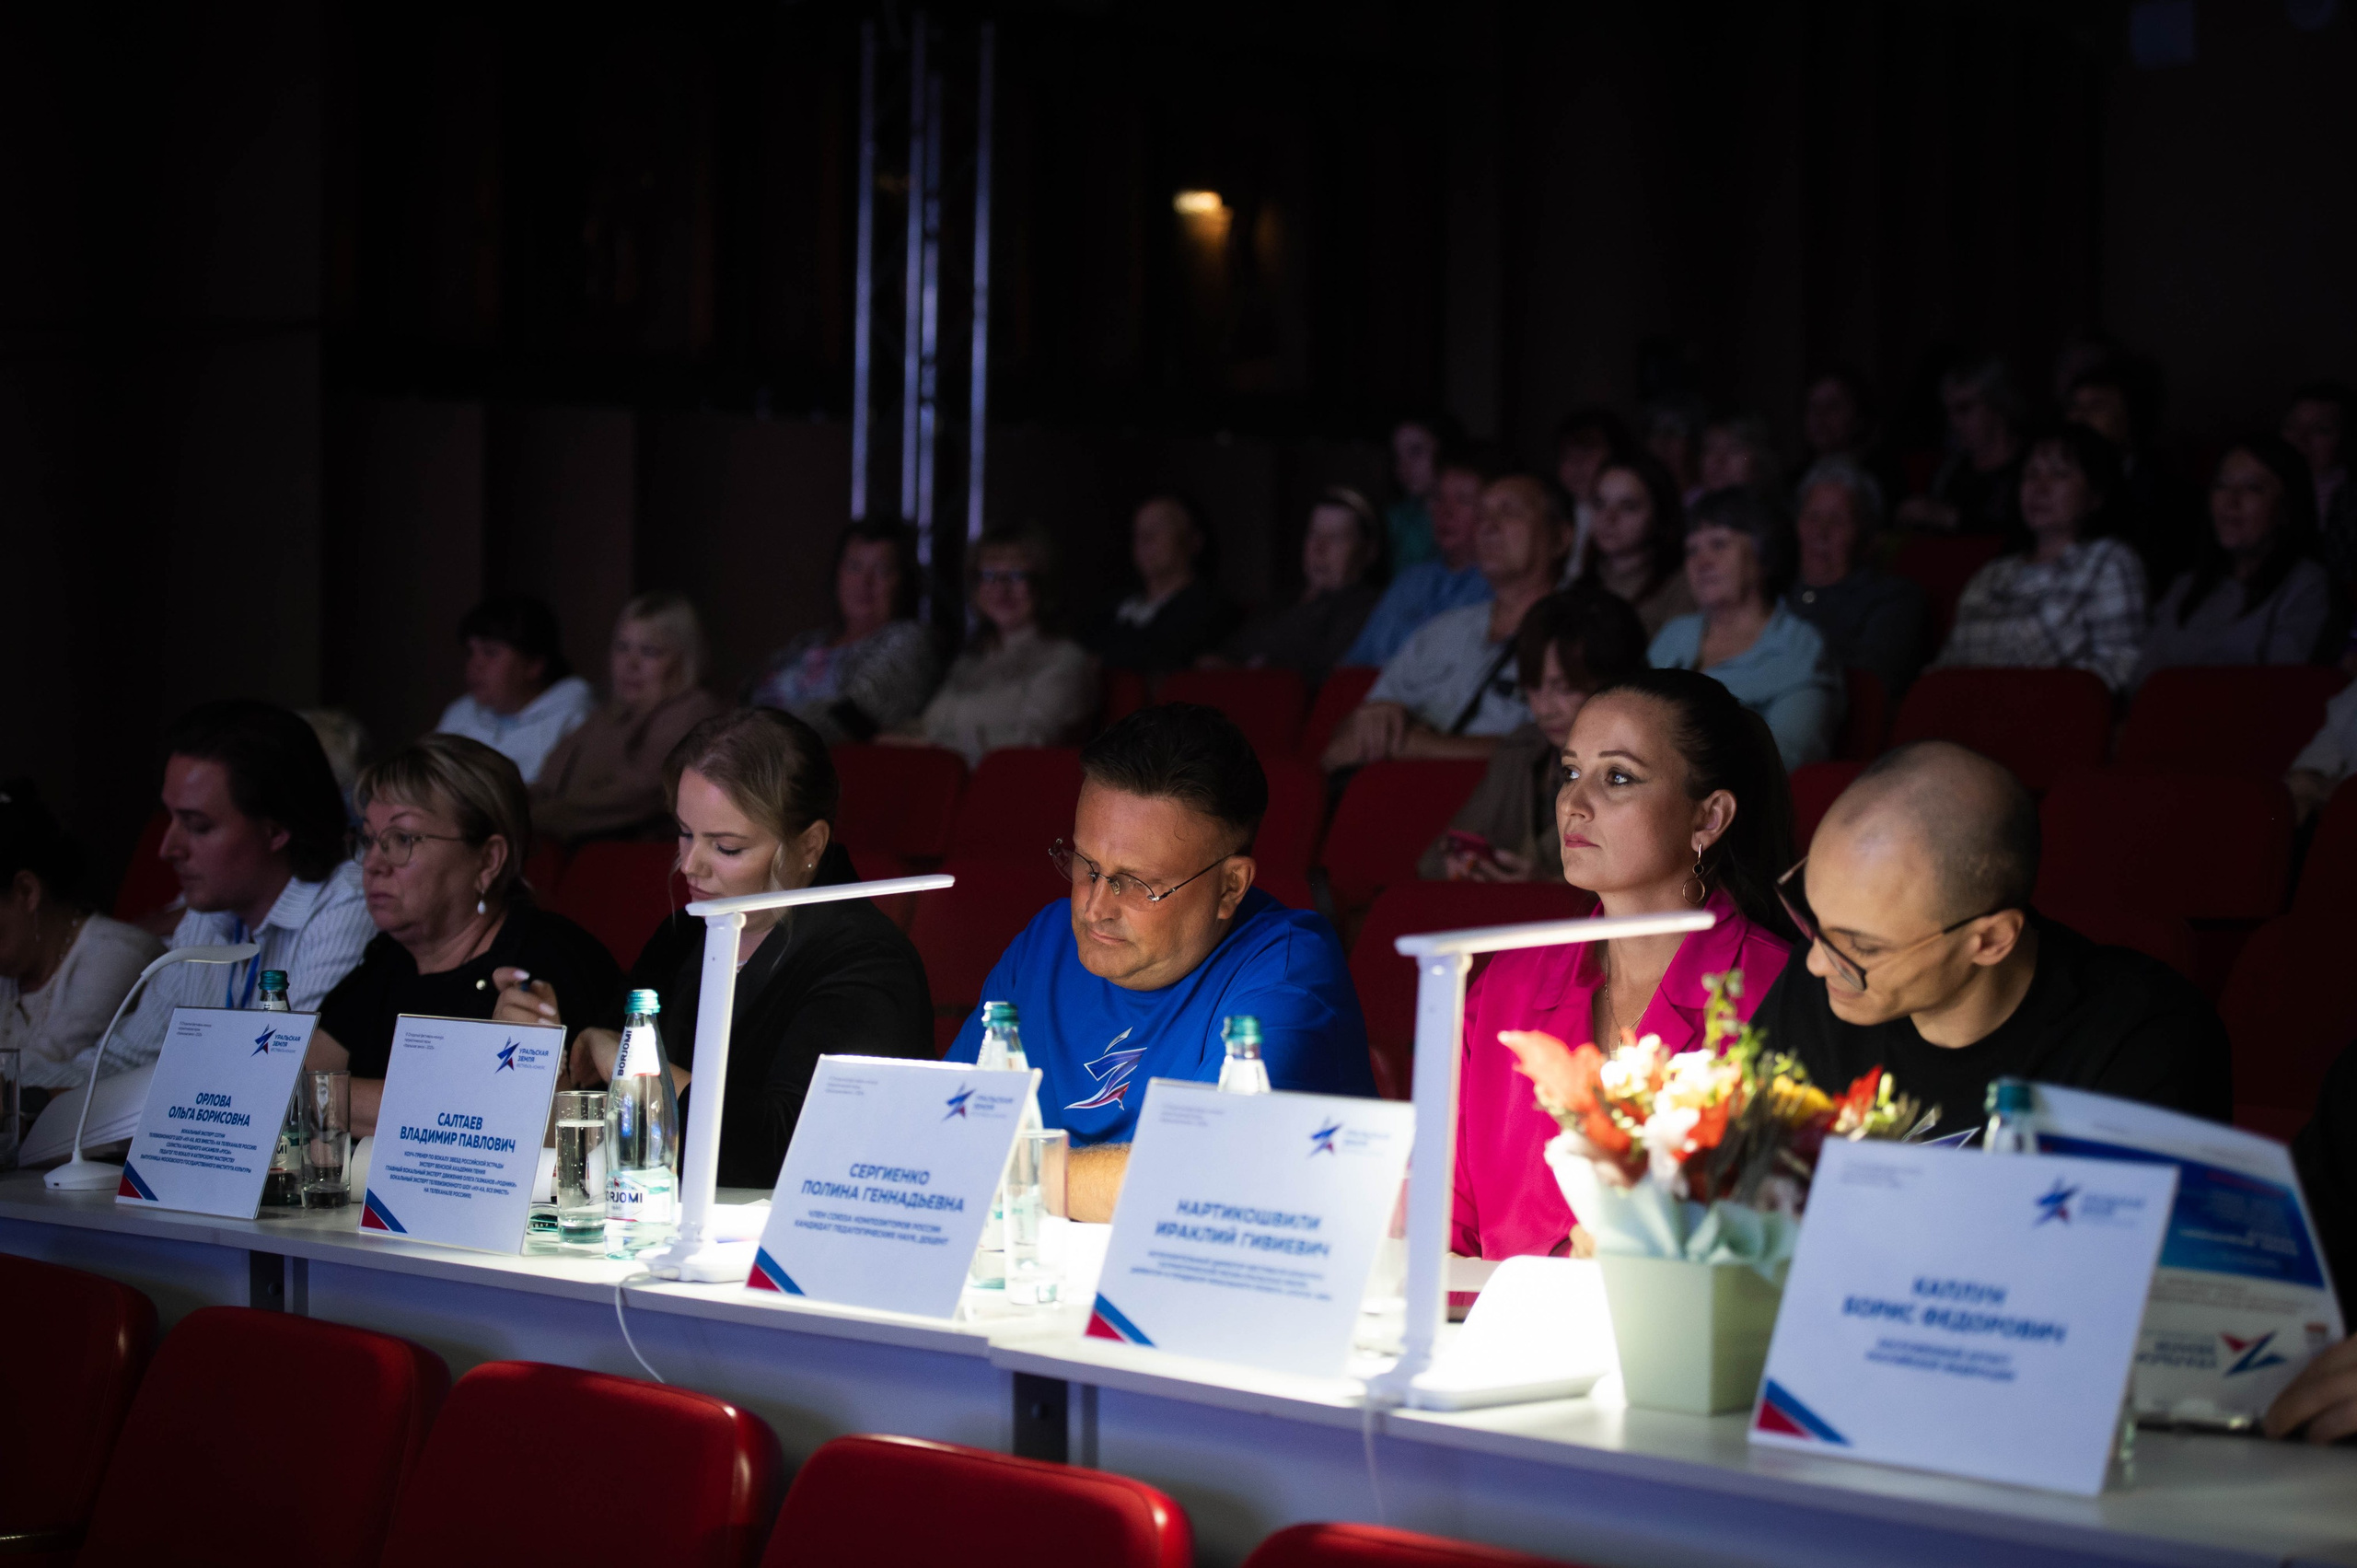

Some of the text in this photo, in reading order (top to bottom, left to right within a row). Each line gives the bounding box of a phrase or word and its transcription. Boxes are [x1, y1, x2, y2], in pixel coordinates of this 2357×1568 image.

[519, 1048, 549, 1057] УРАЛЬСКАЯ
[617, 1030, 632, 1076] BORJOMI
[195, 1092, 232, 1108] ОРЛОВА
[168, 1106, 250, 1127] ОЛЬГА БОРИСОВНА
[437, 1112, 483, 1131] САЛТАЕВ
[400, 1125, 516, 1153] ВЛАДИМИР ПАВЛОВИЧ
[385, 1165, 402, 1173] ГЛАВНЫЙ
[403, 1167, 426, 1176] ВОКАЛЬНЫЙ
[461, 1158, 486, 1167] РОССИЙСКОЙ
[486, 1161, 505, 1169] ЭСТРАДЫ
[389, 1174, 412, 1182] ВОКАЛЬНЫЙ
[849, 1163, 930, 1185] СЕРГИЕНКО
[430, 1188, 453, 1196] ТЕЛЕКАНАЛЕ
[605, 1191, 643, 1203] ORJOMI
[801, 1179, 964, 1213] ПОЛИНА ГЕННАДЬЕВНА
[1177, 1199, 1322, 1230] НАРТИКОШВИЛИ
[1155, 1221, 1329, 1258] ИРАКЛИЙ ГИВИЕВИЧ
[1843, 1295, 2066, 1345] БОРИС ФЕДОРОВИЧ
